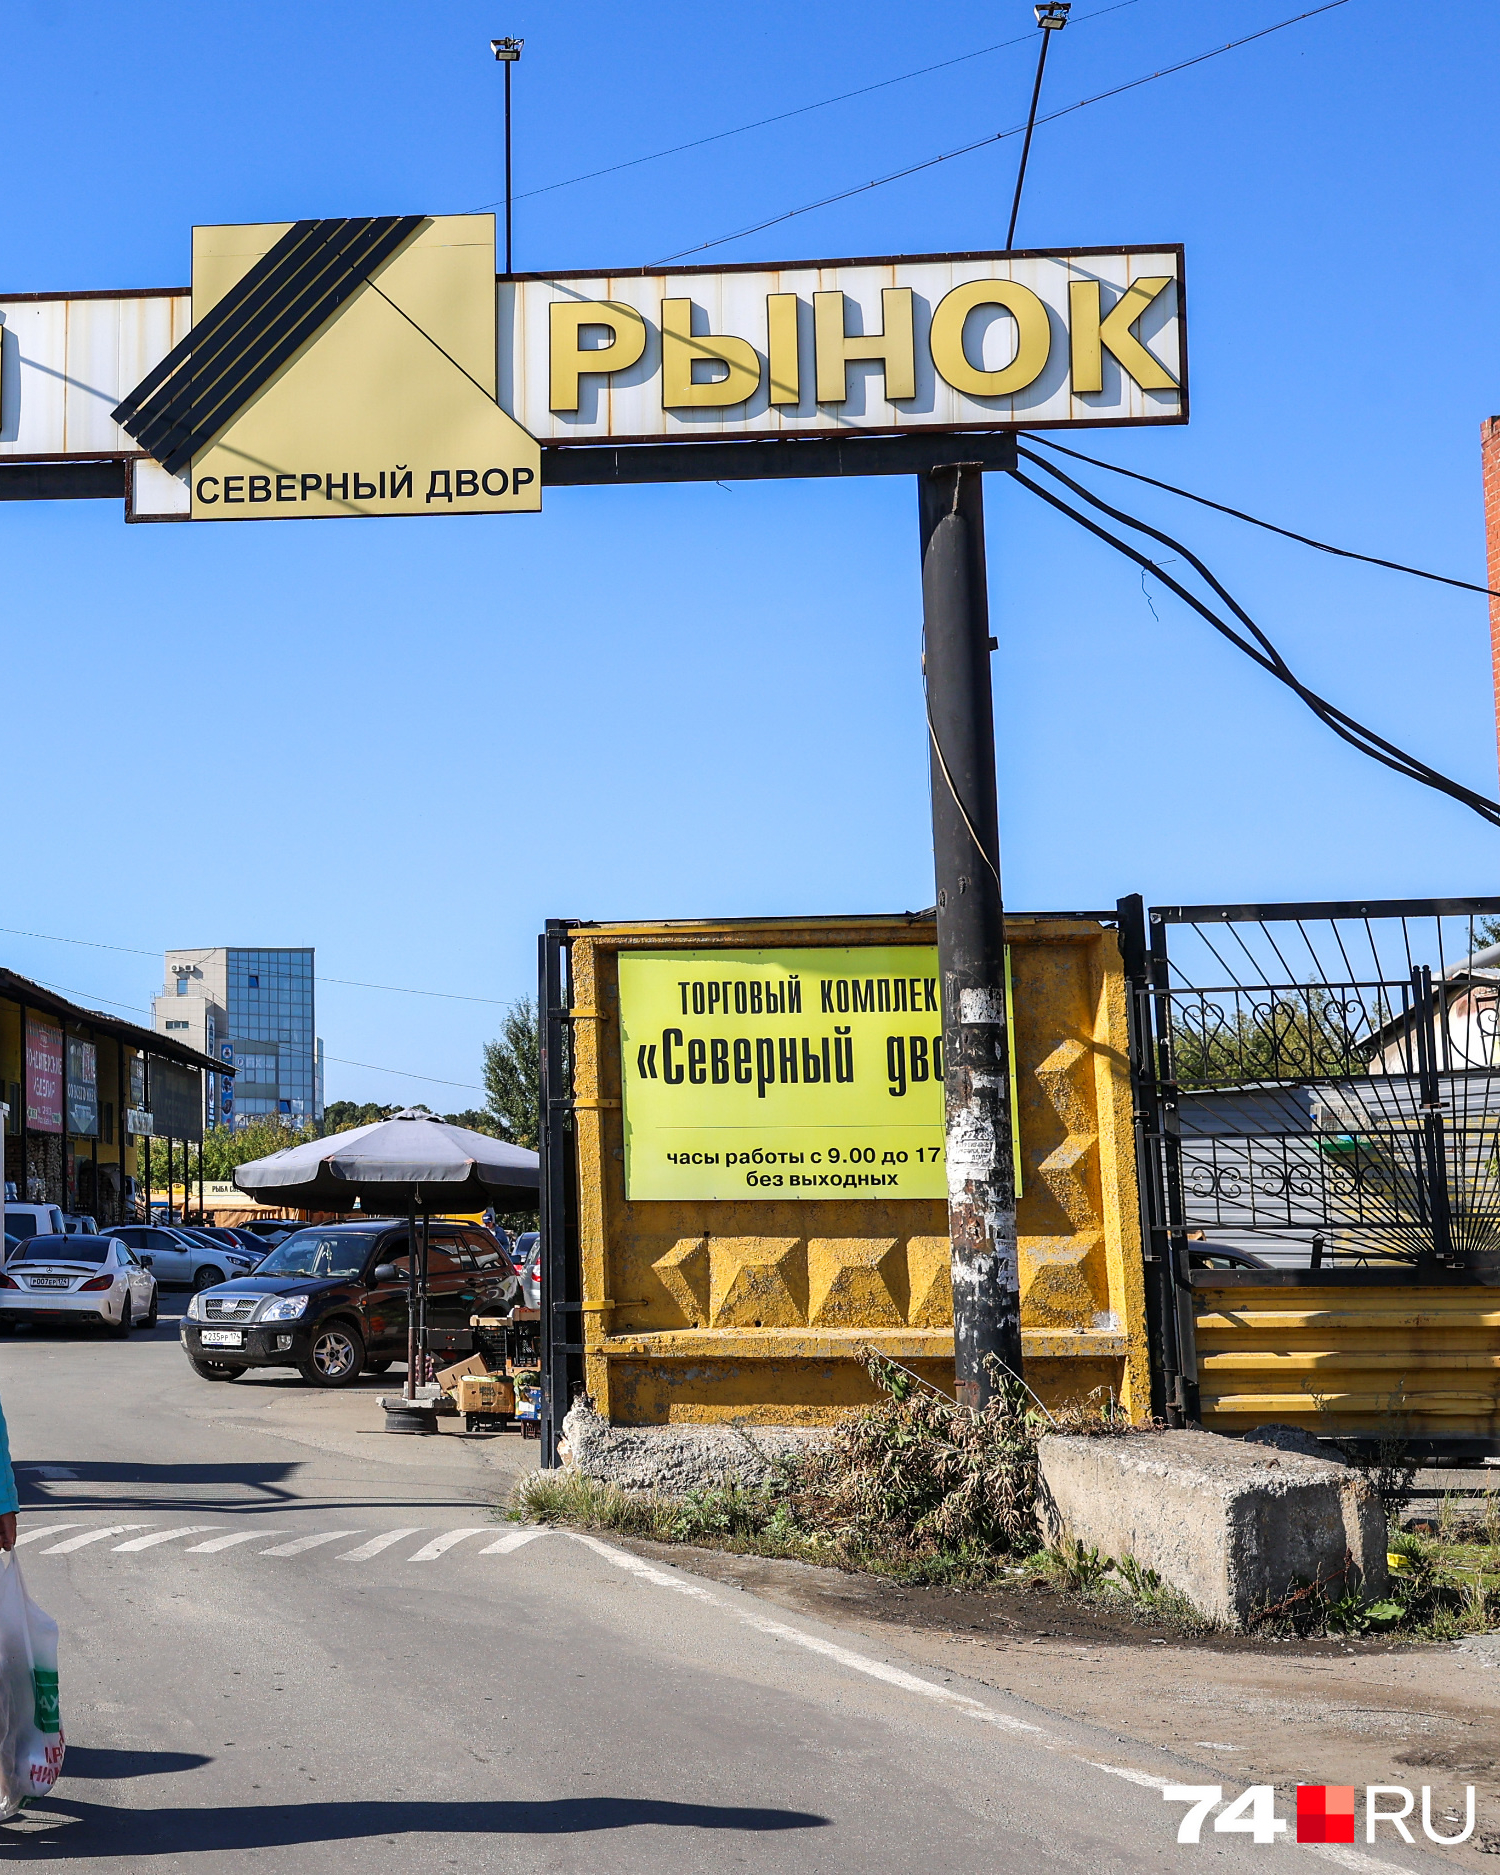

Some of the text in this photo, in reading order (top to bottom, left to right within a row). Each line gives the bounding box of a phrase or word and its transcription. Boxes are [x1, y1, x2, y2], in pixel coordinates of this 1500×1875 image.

[549, 276, 1182, 412] РЫНОК
[196, 464, 535, 504] СЕВЕРНЫЙ ДВОР
[678, 974, 939, 1015] ТОРГОВЫЙ КОМПЛЕК
[636, 1026, 854, 1099] «Северный
[667, 1150, 720, 1164] часы
[725, 1147, 805, 1167] работы
[810, 1150, 822, 1163] с
[828, 1147, 876, 1163] 9.00
[881, 1149, 909, 1166] до
[746, 1170, 899, 1188] без выходных
